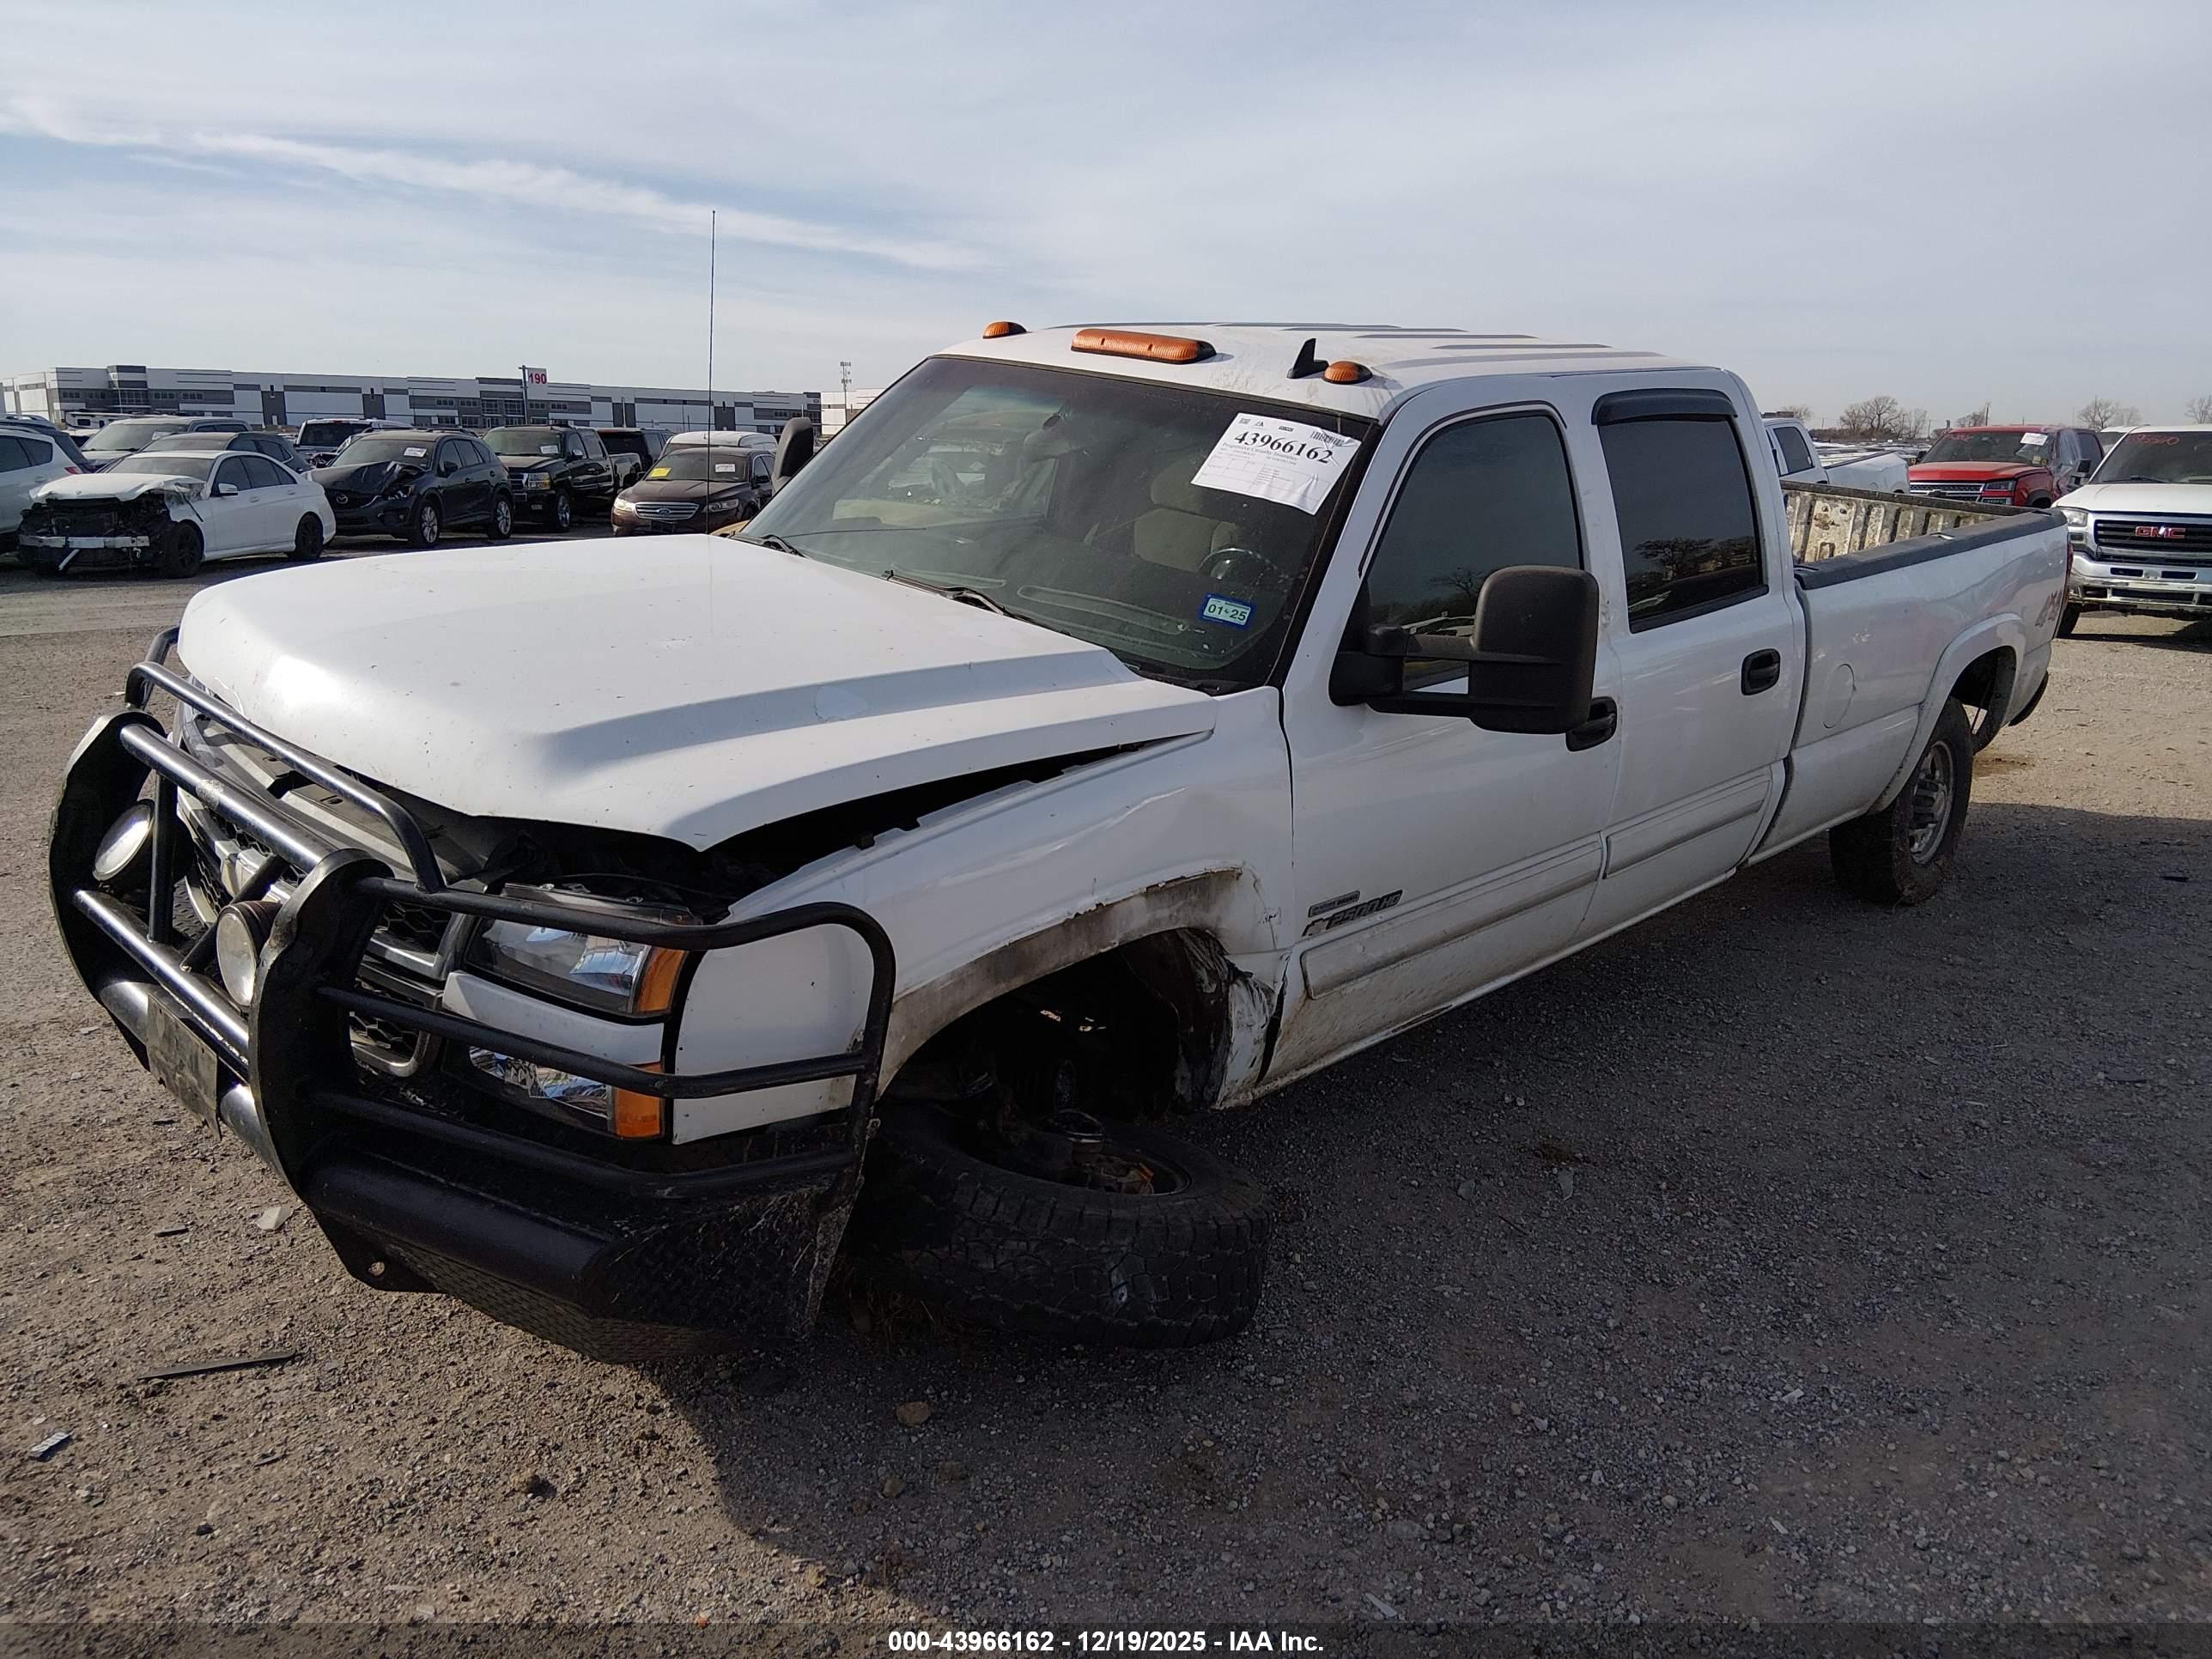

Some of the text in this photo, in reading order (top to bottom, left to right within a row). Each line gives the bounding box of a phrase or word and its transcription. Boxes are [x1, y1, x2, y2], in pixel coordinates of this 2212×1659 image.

[528, 373, 547, 384] 190
[1234, 430, 1334, 464] 43966162
[2136, 526, 2186, 538] GMC
